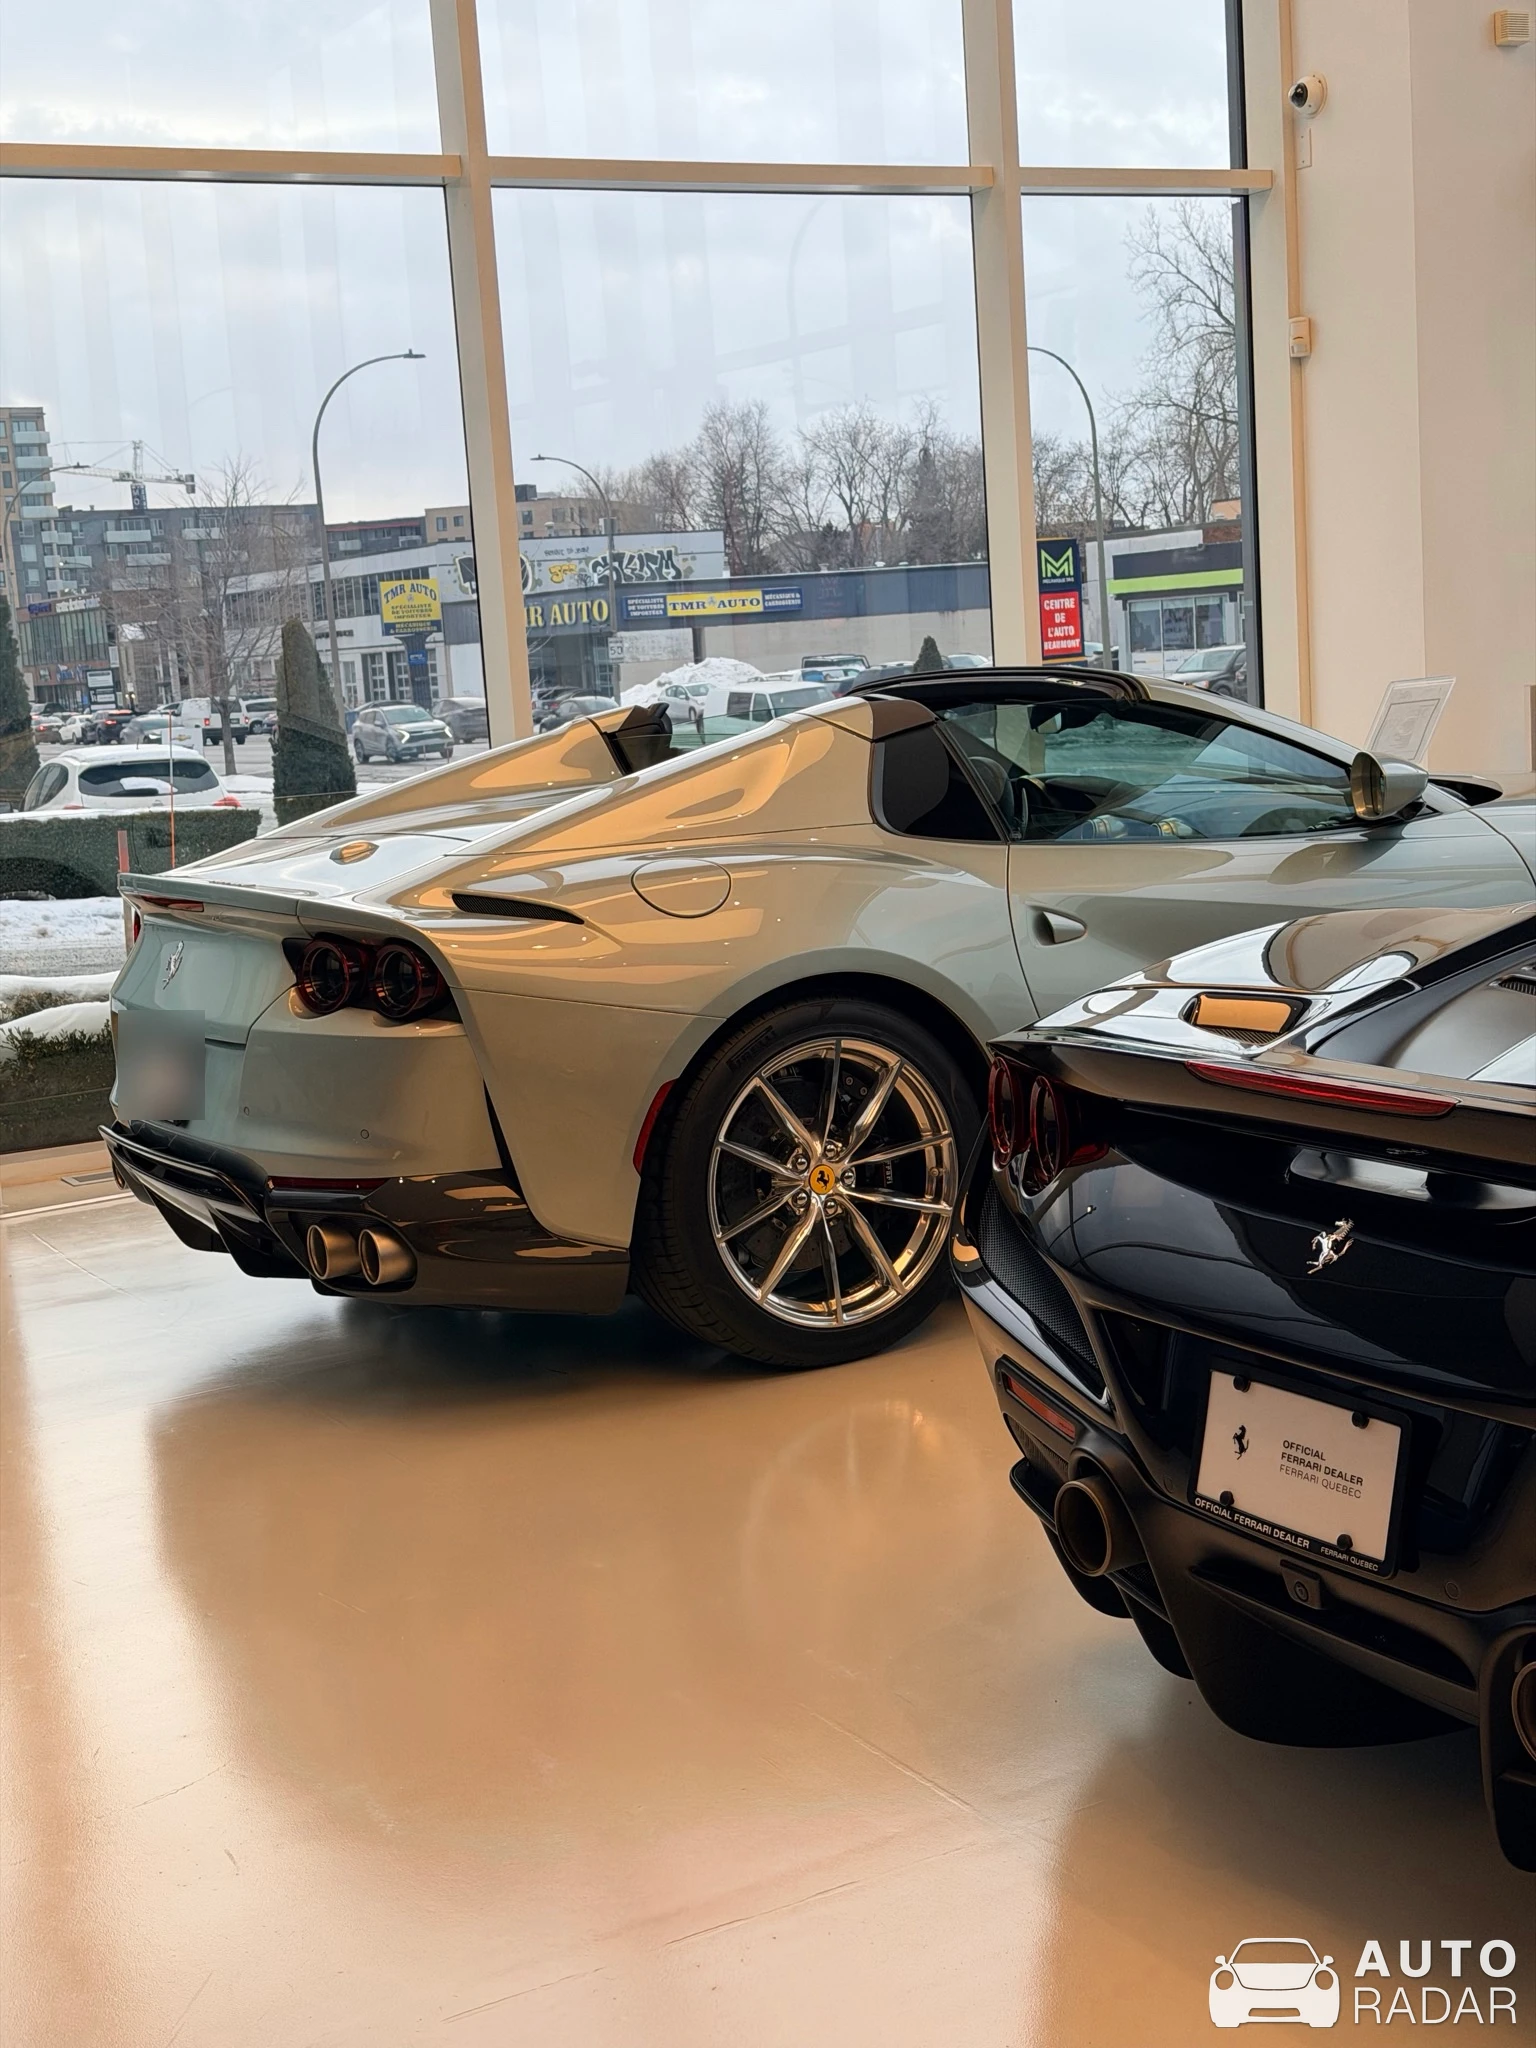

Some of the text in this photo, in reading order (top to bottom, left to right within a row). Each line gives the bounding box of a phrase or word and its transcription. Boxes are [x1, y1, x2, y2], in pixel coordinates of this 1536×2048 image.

[384, 583, 437, 604] TMR AUTO
[1044, 598, 1075, 610] CENTRE
[550, 599, 609, 626] AUTO
[669, 598, 761, 611] TMR AUTO
[1054, 613, 1066, 623] DE
[1048, 625, 1075, 637] L'AUTO
[1044, 638, 1081, 650] BEAUMONT
[1283, 1440, 1326, 1461] OFFICIAL
[1281, 1452, 1363, 1486] FERRARI DEALER
[1280, 1464, 1361, 1499] FERRARI QUEBEC
[1195, 1497, 1310, 1549] OFFICIAL FERRARI DEALER
[1320, 1546, 1379, 1572] FERRARI QUEBEC
